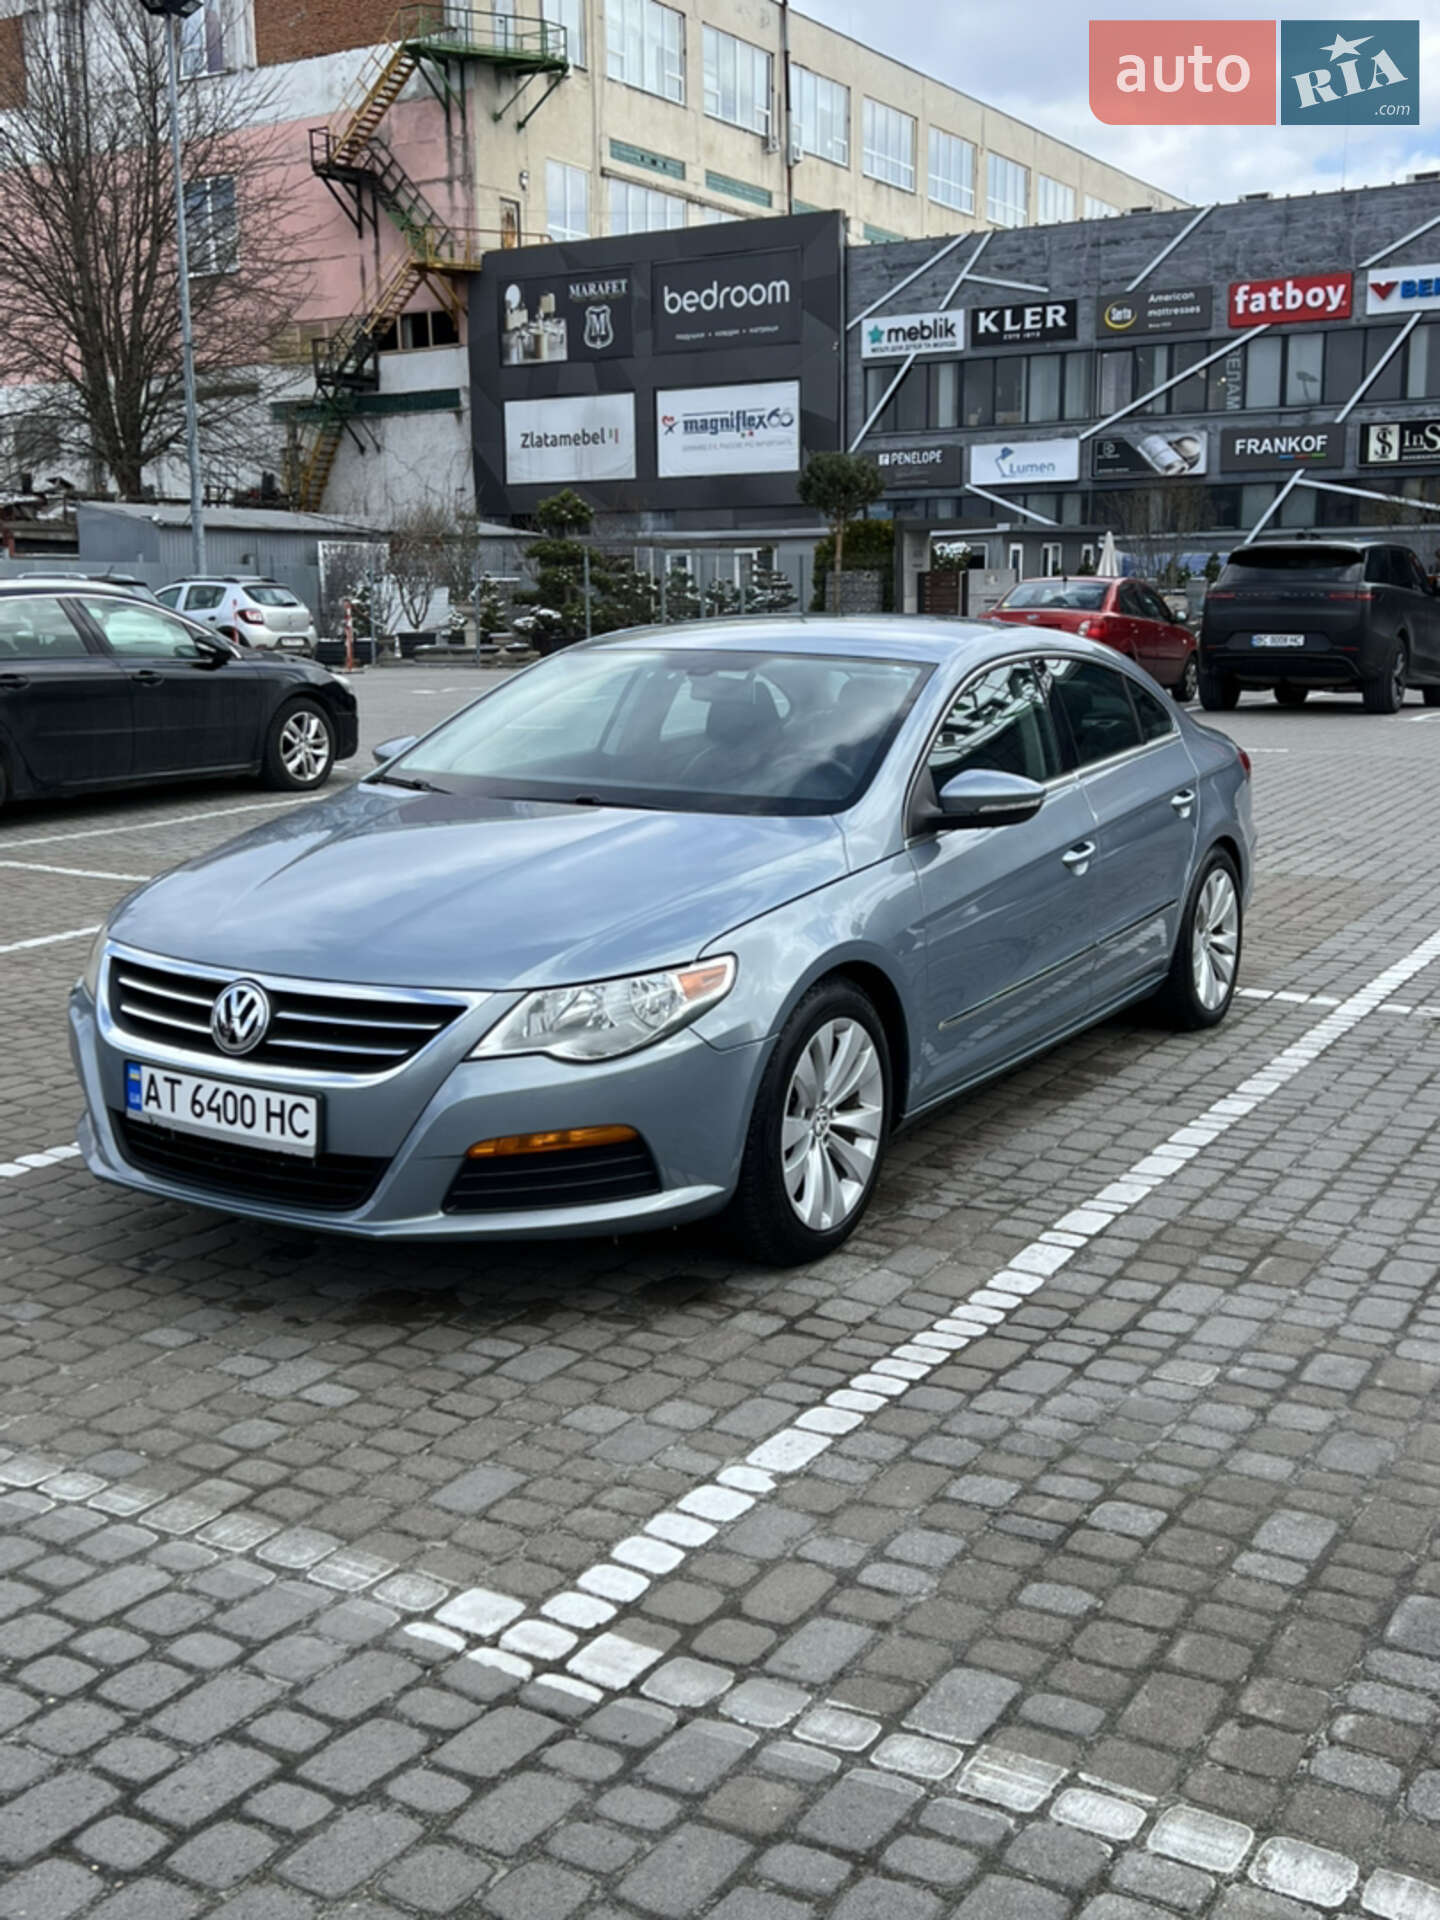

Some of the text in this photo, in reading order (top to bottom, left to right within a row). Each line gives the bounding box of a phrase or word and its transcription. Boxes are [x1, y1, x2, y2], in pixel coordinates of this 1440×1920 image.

[569, 279, 628, 299] MARAFET
[664, 279, 790, 314] bedroom
[1148, 291, 1195, 303] American
[1234, 280, 1346, 315] fatboy
[978, 304, 1068, 334] KLER
[1147, 305, 1200, 317] mattresses
[886, 318, 957, 343] meblik
[520, 426, 606, 449] Zlatamebel
[1235, 435, 1327, 456] FRANKOF
[890, 450, 943, 465] PENELOPE
[1009, 462, 1056, 474] Lumen
[145, 1073, 309, 1139] AT 6400 HC
